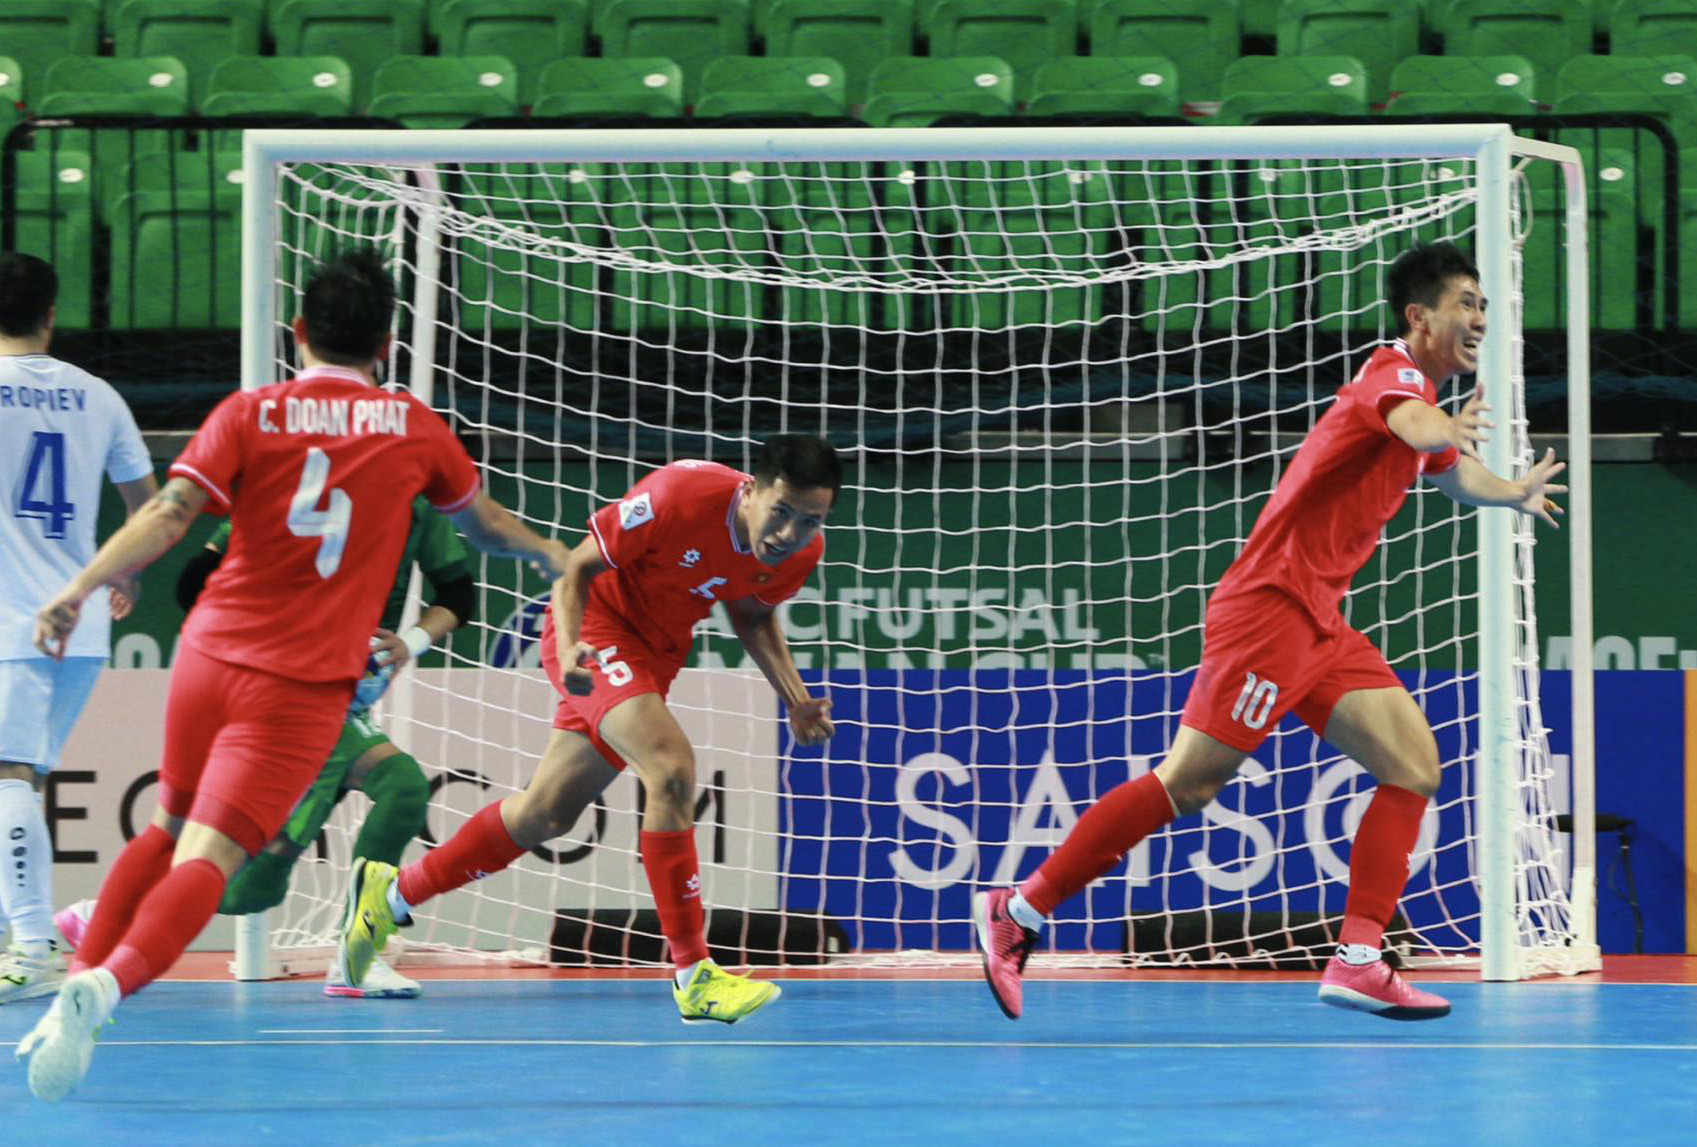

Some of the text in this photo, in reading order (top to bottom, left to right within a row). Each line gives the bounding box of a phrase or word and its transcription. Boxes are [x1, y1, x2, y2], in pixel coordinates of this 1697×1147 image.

[285, 396, 349, 437] DOAN
[352, 398, 411, 437] PHAT
[14, 430, 76, 540] 4
[286, 446, 353, 580] 4
[692, 585, 1100, 641] AC FUTSAL
[597, 644, 634, 687] 5
[1230, 671, 1279, 730] 10
[888, 748, 1570, 891] SAISO
